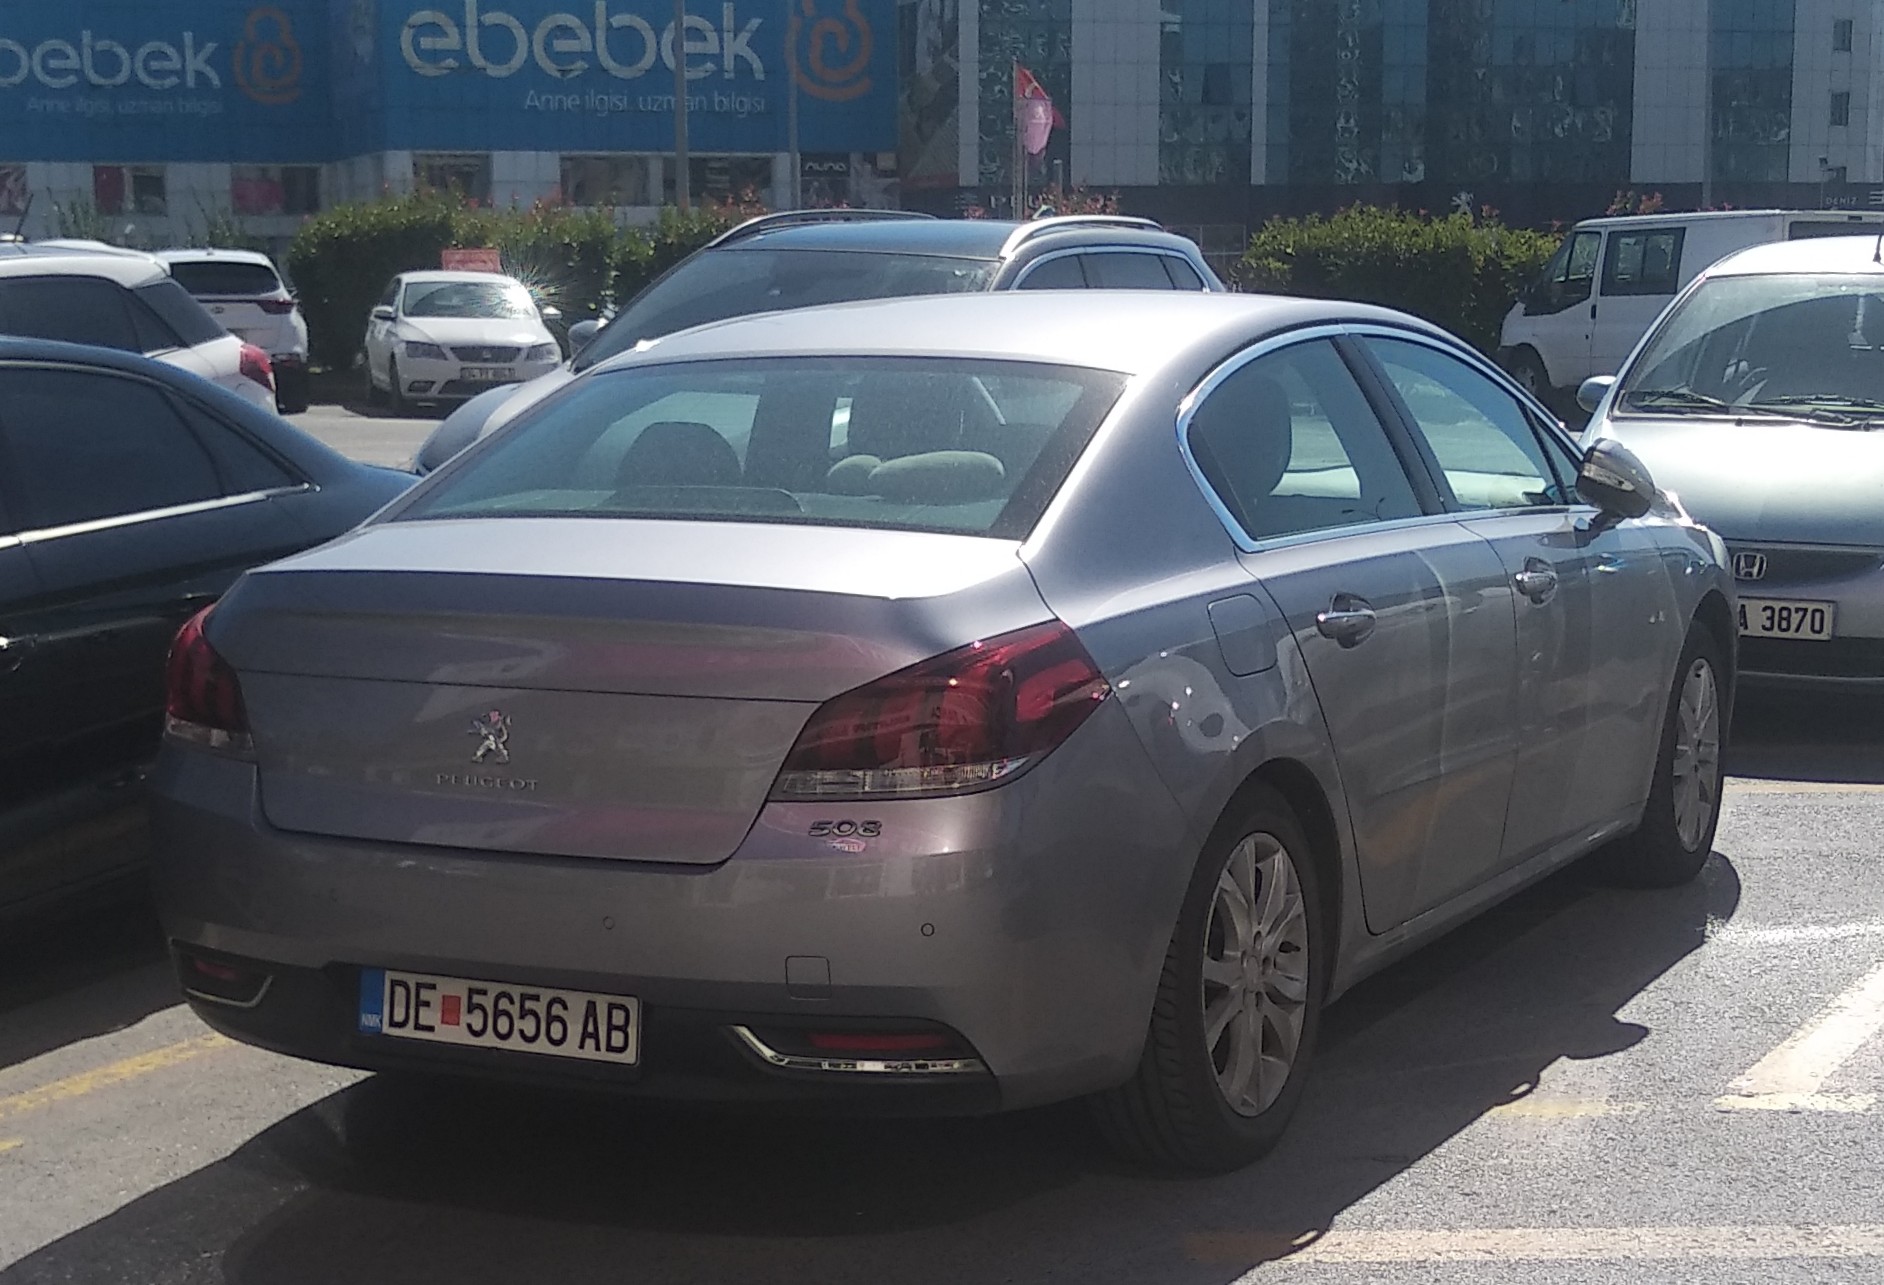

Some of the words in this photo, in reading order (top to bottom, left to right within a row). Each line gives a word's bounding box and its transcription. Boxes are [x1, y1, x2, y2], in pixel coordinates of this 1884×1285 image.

[401, 0, 765, 80] ebebek
[525, 90, 580, 111] Anne
[714, 90, 765, 118] bilgisi
[1760, 605, 1825, 634] 3870
[436, 773, 537, 791] PEUGEOT
[808, 819, 883, 838] 508
[387, 978, 437, 1033] DE
[466, 986, 569, 1047] 5656
[577, 999, 631, 1054] AB
